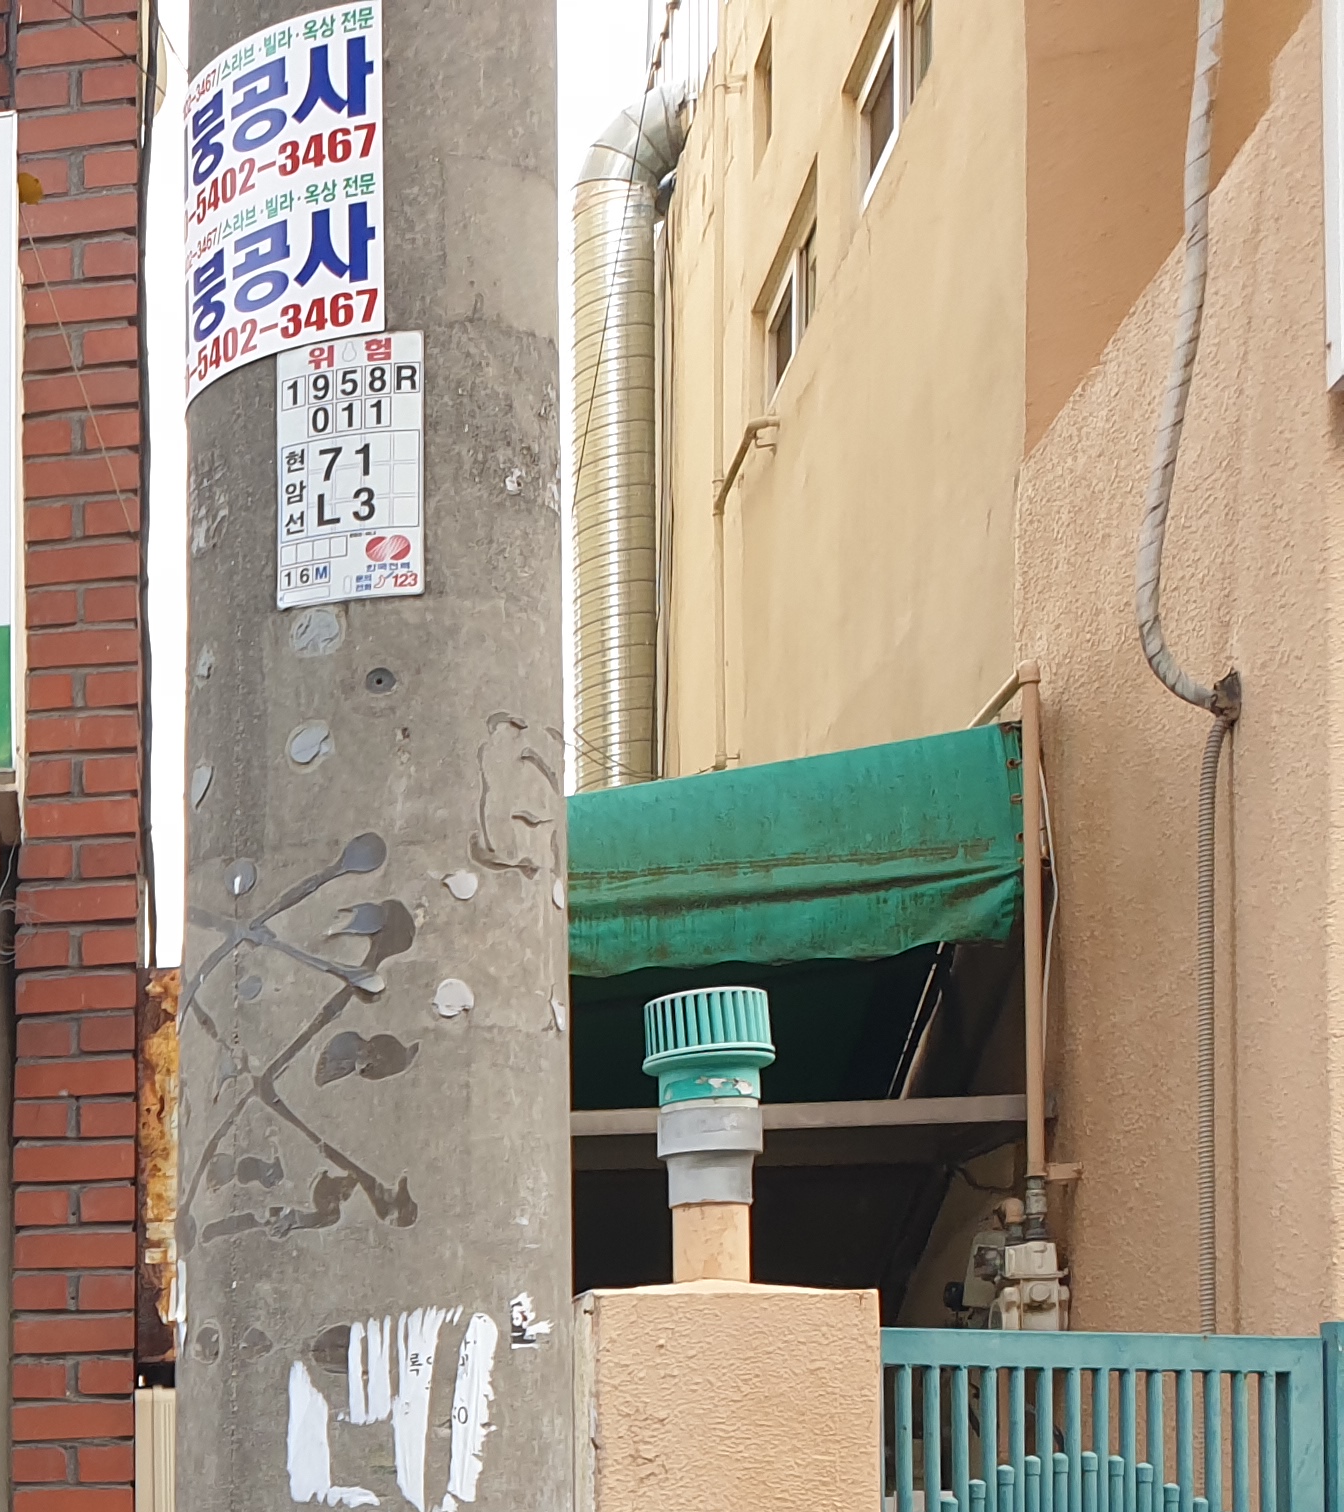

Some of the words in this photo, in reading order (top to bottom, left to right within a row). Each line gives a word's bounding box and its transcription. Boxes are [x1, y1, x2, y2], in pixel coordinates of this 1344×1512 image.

[184, 123, 376, 245] -5402-3467
[184, 288, 378, 390] -5402-3467
[392, 572, 418, 588] 123
